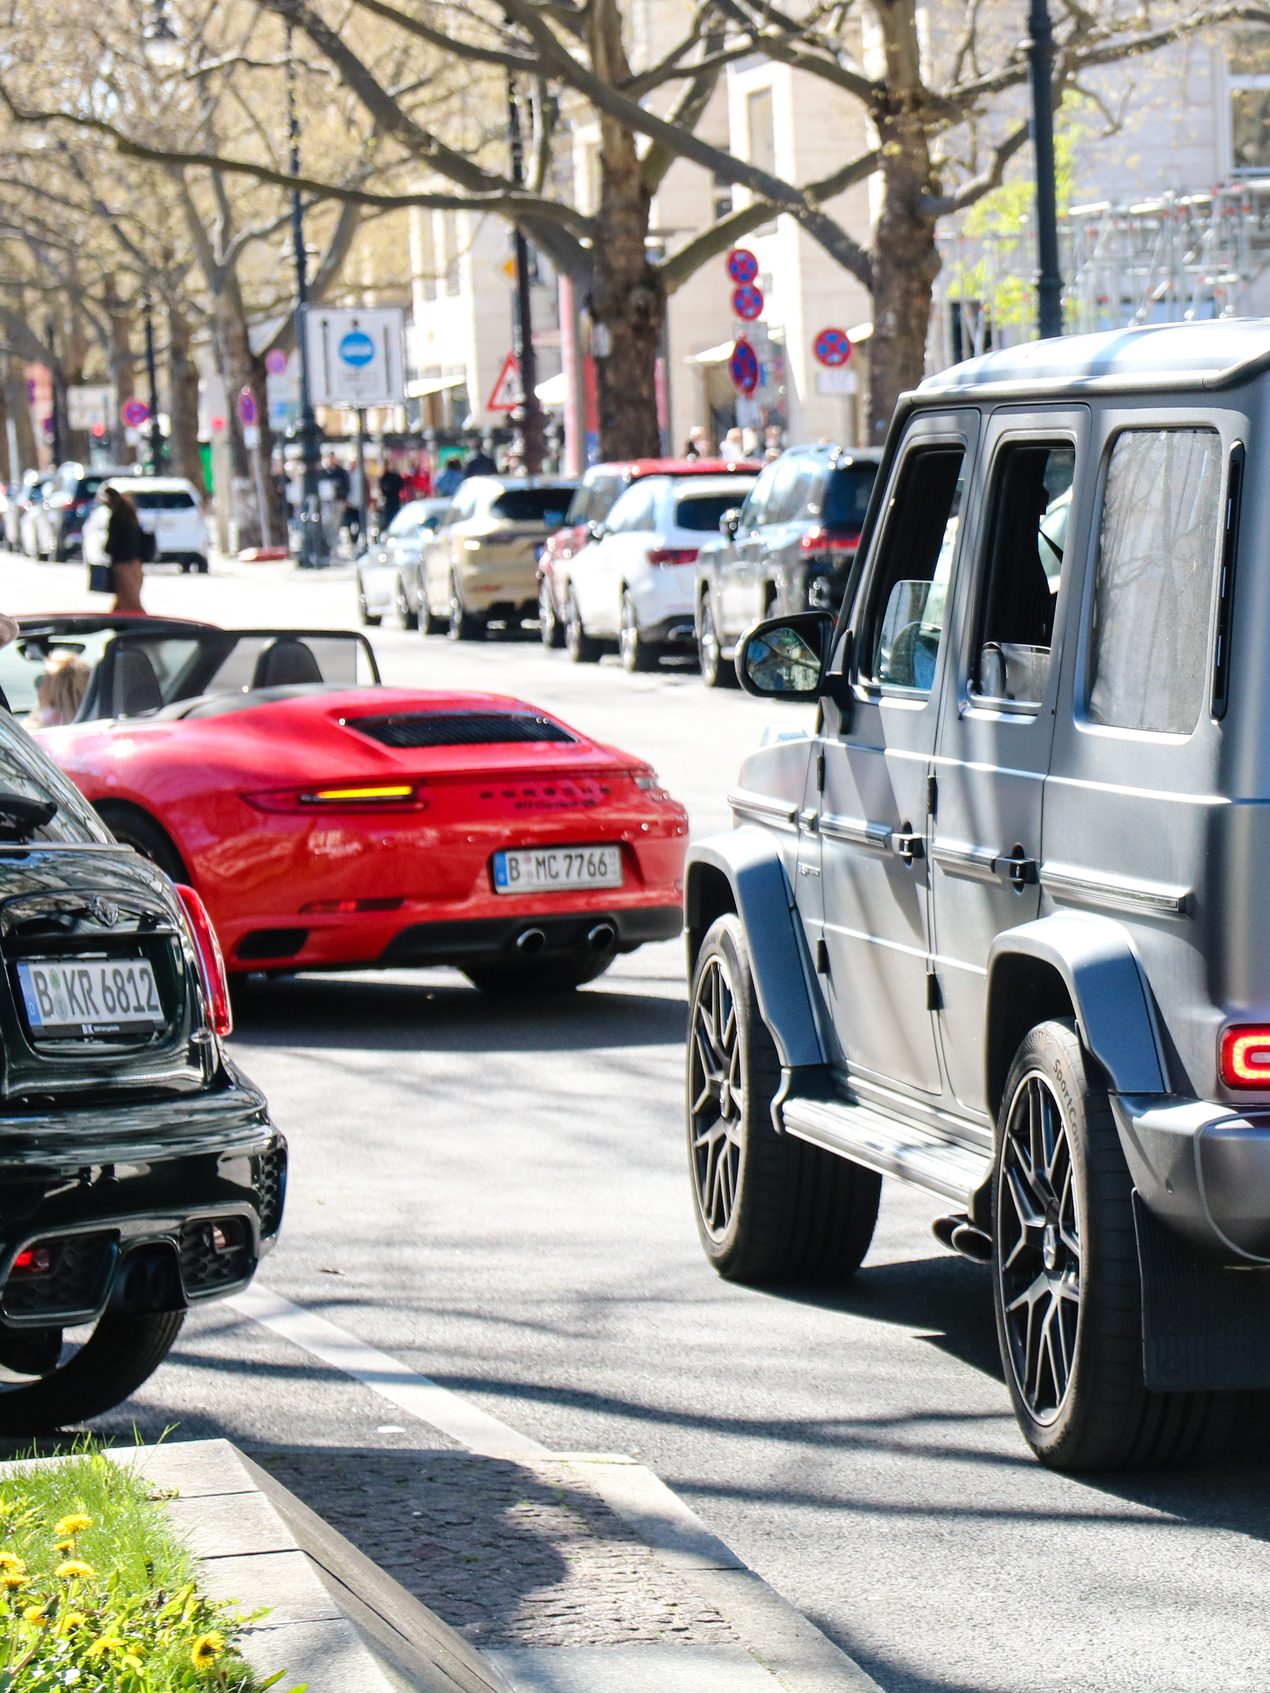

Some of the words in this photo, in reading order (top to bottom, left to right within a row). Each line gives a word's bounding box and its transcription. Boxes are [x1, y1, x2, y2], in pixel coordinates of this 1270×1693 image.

[508, 856, 521, 882] B
[535, 854, 559, 880] MC
[562, 852, 608, 879] 7766
[32, 970, 55, 1018] B
[62, 969, 100, 1017] KR
[100, 967, 160, 1014] 6812
